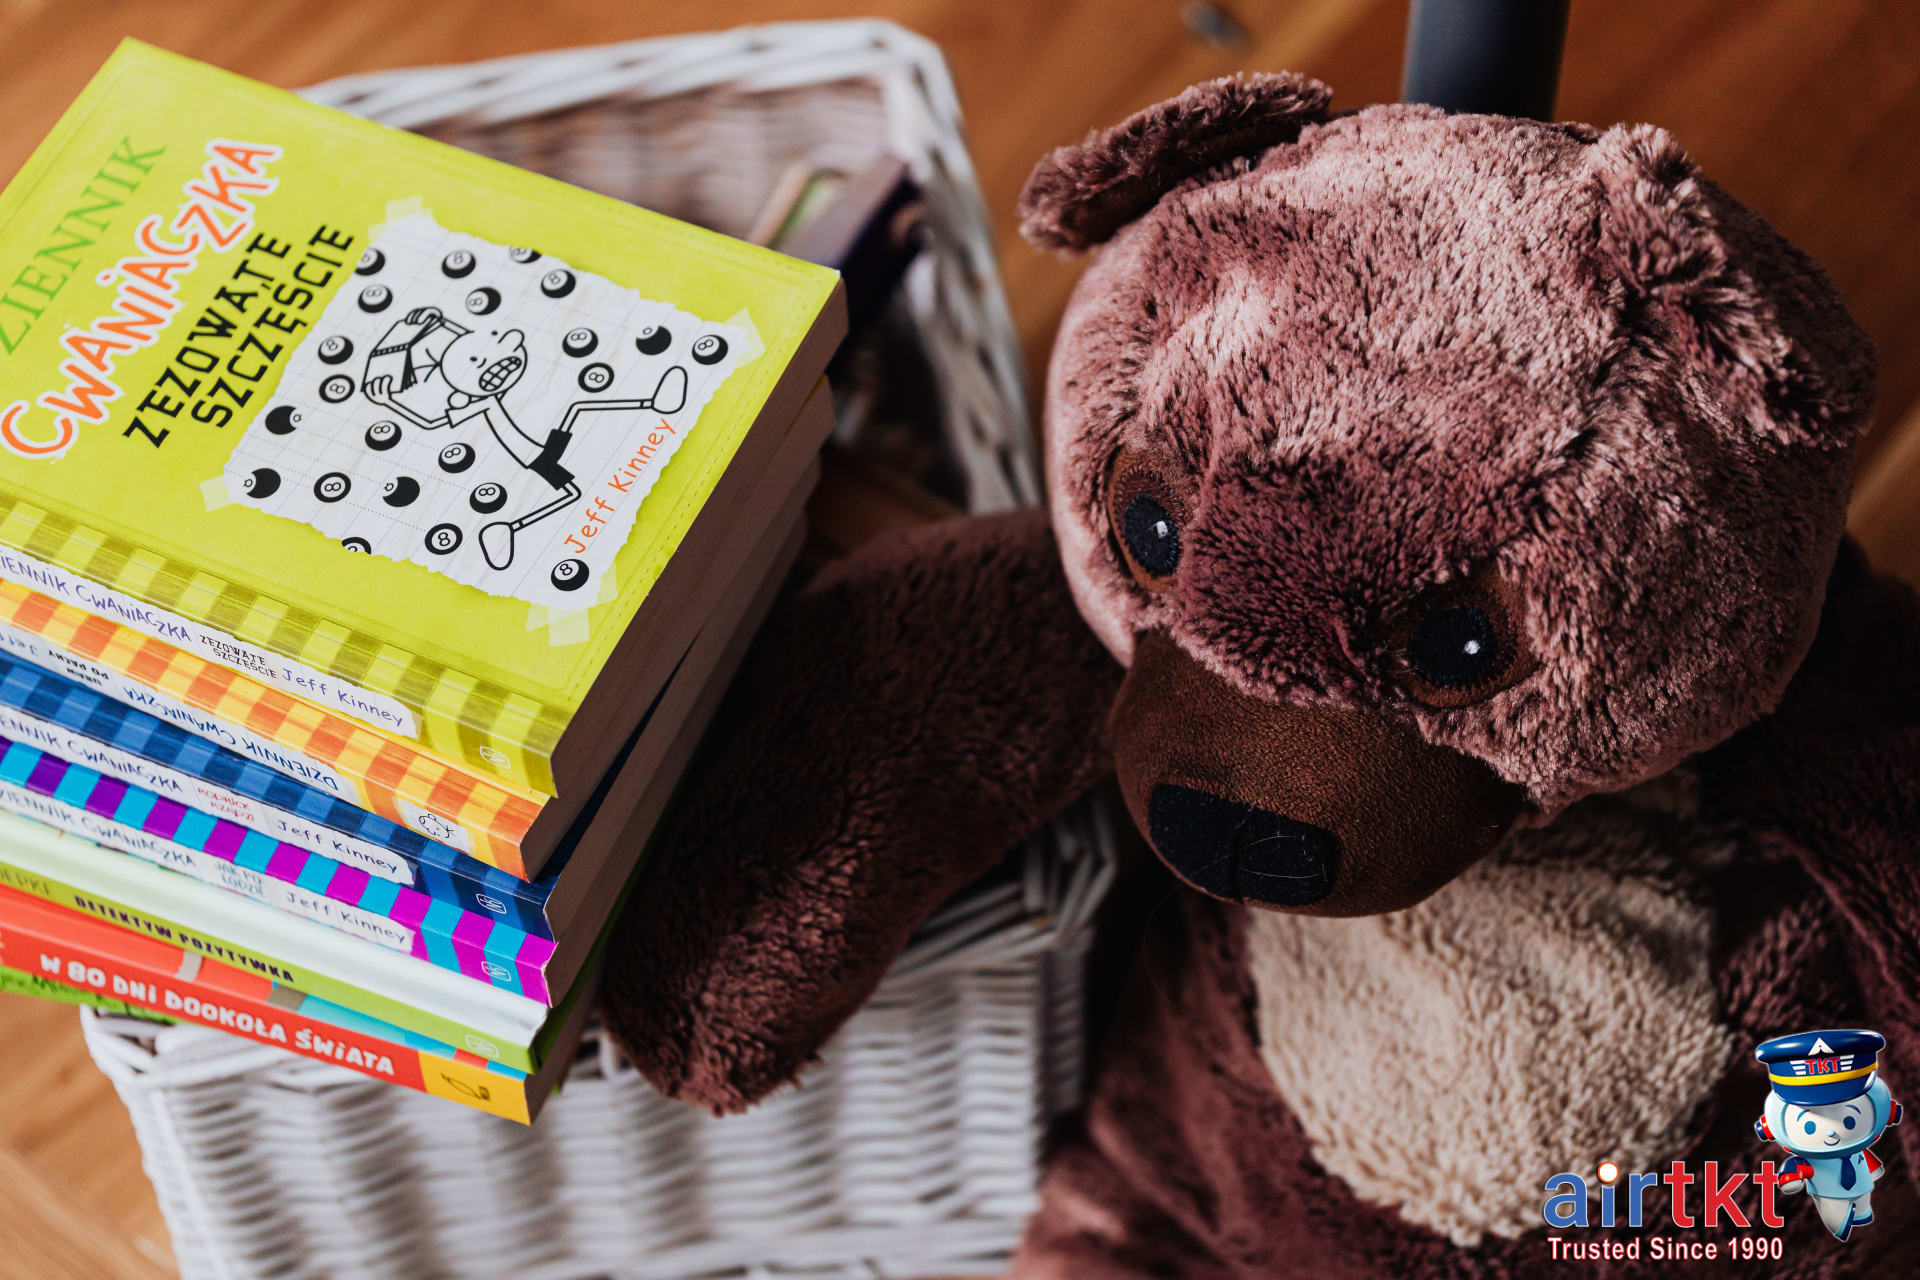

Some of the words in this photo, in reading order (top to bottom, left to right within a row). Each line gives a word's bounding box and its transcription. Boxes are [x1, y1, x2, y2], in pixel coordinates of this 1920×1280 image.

[122, 232, 292, 449] ZEZOWATE
[190, 224, 355, 428] SZCZĘŚCIE
[564, 496, 615, 554] Jeff
[606, 417, 677, 493] Kinney
[199, 634, 267, 666] ZEZOWATE
[281, 668, 328, 696] Jeff
[337, 689, 404, 728] Kinney
[242, 737, 340, 791] DZIENNIK
[278, 819, 321, 844] Jeff
[332, 840, 398, 875] Kinney
[74, 895, 172, 940] DETEKTYW
[179, 932, 295, 984] POZYTYWKA
[286, 891, 329, 916] Jeff
[340, 910, 406, 944] Kinney
[40, 953, 61, 975] W
[67, 960, 107, 988] 80
[164, 988, 288, 1044] DOOKOŁA
